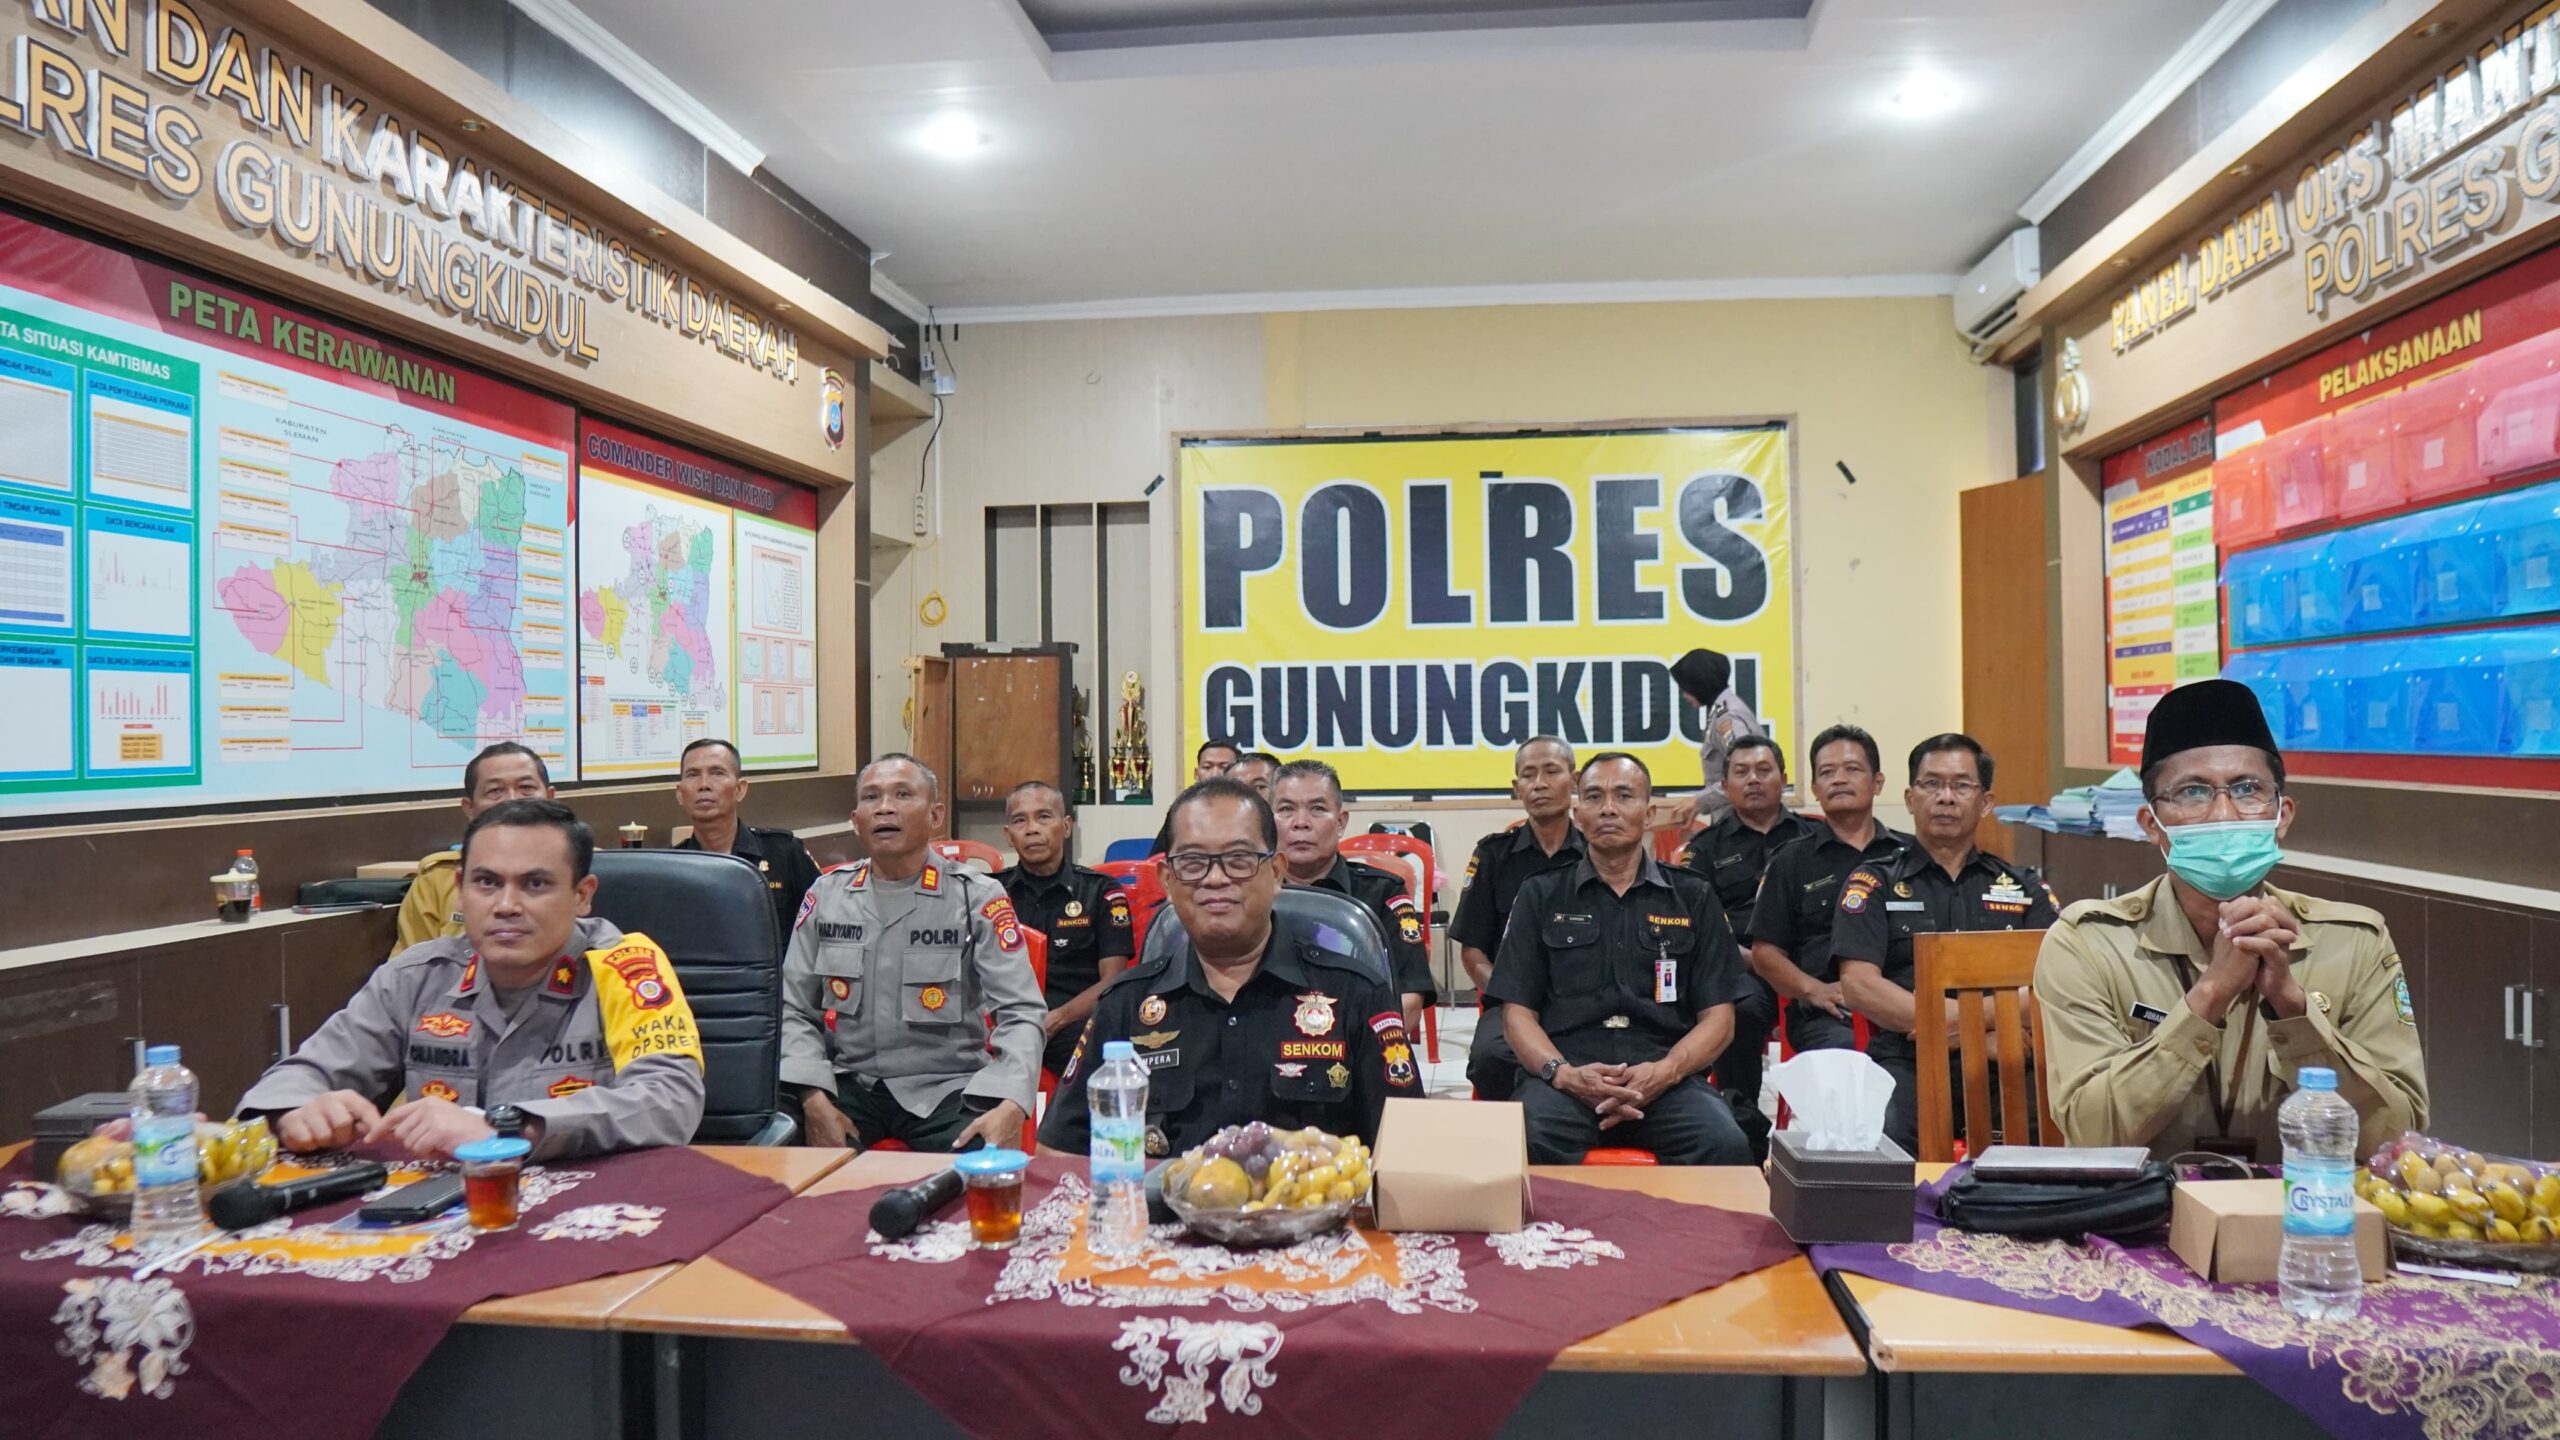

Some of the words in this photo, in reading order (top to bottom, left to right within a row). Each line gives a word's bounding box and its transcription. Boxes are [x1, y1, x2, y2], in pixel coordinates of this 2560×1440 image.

[148, 0, 313, 148] DAN
[322, 83, 680, 325] KARAKTERISTIK
[681, 276, 799, 380] DAERAH
[216, 139, 599, 362] GUNUNGKIDUL
[2111, 253, 2196, 350] PANEL
[2199, 191, 2289, 297] DATA
[2295, 121, 2383, 235] OPS
[2305, 145, 2506, 316] POLRES
[23, 327, 83, 357] SITUASI
[87, 346, 170, 379] KAMTIBMAS
[170, 282, 262, 350] PETA
[273, 316, 456, 404] KERAWANAN
[2319, 308, 2482, 404] PELAKSANAAN
[275, 417, 327, 435] KABUPATEN
[283, 429, 318, 443] SLEMAN
[587, 433, 674, 480] COMANDER
[676, 462, 711, 494] WISH
[714, 474, 740, 500] DAN
[743, 480, 774, 510] KRYD
[2146, 439, 2187, 478] KODAL
[1202, 475, 1769, 628] POLRES
[910, 928, 958, 945] POLRI
[1649, 915, 1690, 926] SENKOM
[632, 1015, 687, 1038] WAKA
[1283, 1043, 1342, 1057] SENKOM
[1140, 1054, 1171, 1066] MPERA
